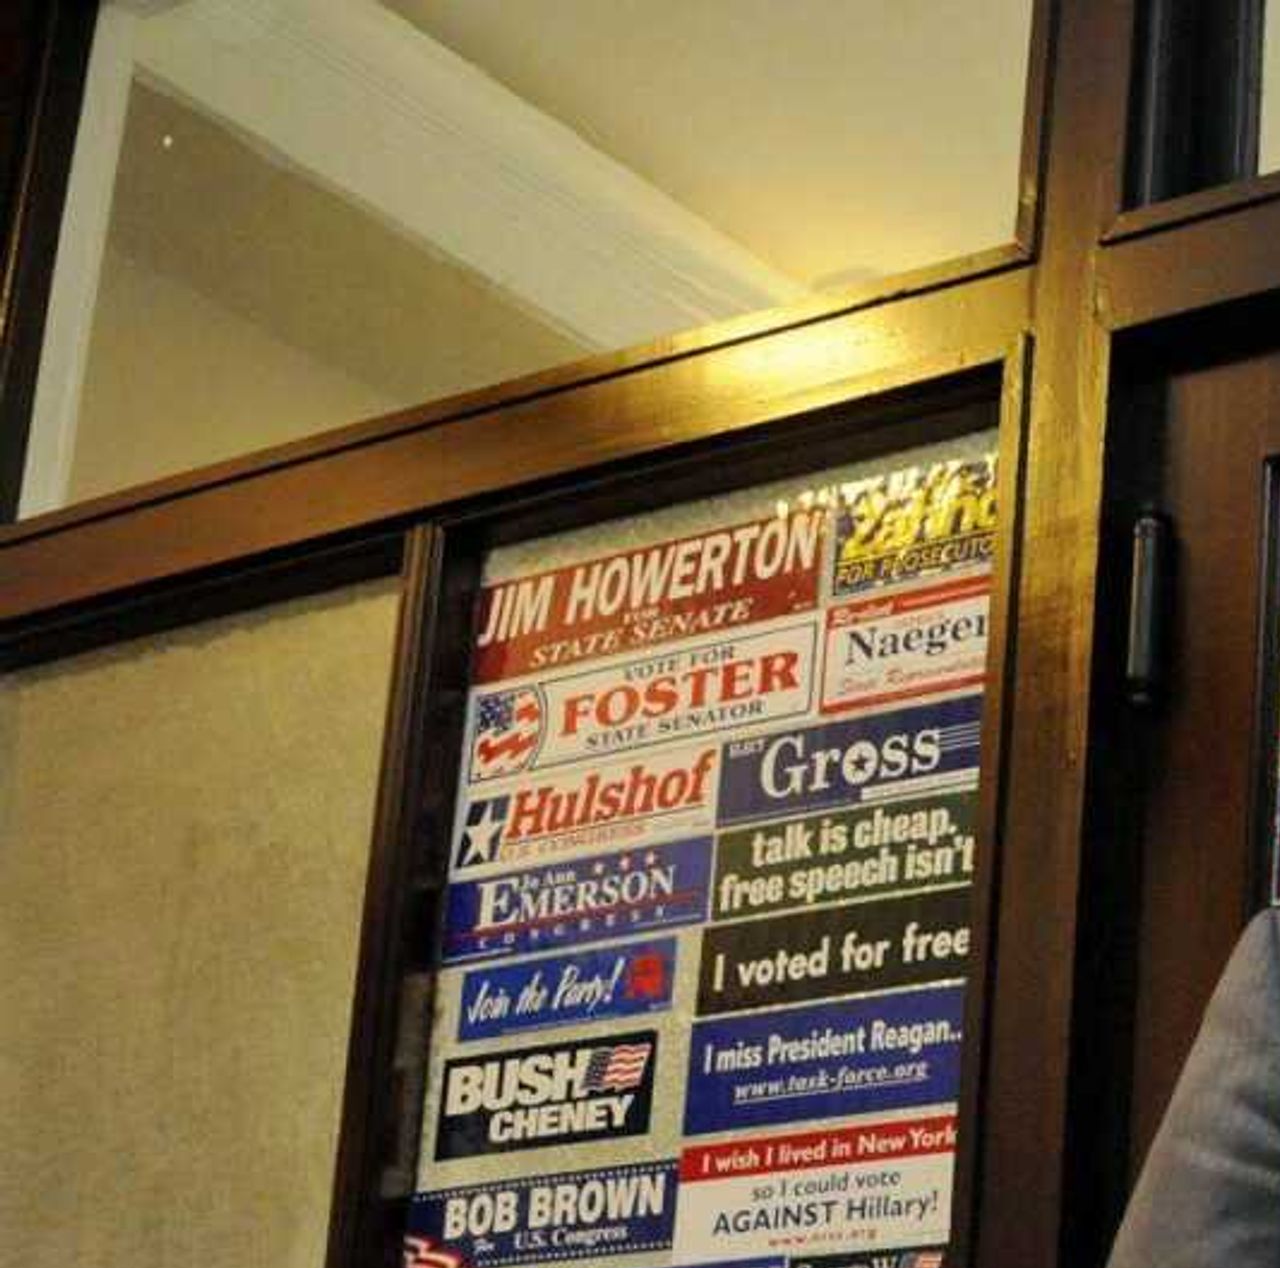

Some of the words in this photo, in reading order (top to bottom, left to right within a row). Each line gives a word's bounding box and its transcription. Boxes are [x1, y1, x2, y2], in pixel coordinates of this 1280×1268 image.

[478, 579, 556, 647] JIM
[565, 511, 822, 624] HOWERTON
[530, 627, 626, 667] STATE
[633, 598, 753, 645] SENATE
[561, 650, 801, 736] FOSTER
[586, 725, 649, 751] STATE
[658, 700, 765, 738] SENATOR
[507, 748, 716, 839] Hulshof
[761, 728, 941, 799] Gross
[752, 822, 812, 867] talk
[820, 819, 847, 855] is
[854, 807, 957, 848] cheap.
[474, 865, 676, 932] EMERSON
[720, 874, 783, 912] free
[790, 848, 897, 903] speech
[905, 836, 974, 880] isn't
[467, 979, 510, 1024] Join
[552, 956, 626, 1013] Party!
[713, 954, 725, 992] I
[738, 935, 830, 986] voted
[841, 931, 890, 972] for
[902, 922, 971, 962] free
[445, 1049, 594, 1116] BUSH
[715, 1042, 763, 1072] miss
[767, 1028, 866, 1064] President
[489, 1094, 634, 1143] CHENEY
[715, 1148, 759, 1173] wish
[777, 1141, 826, 1165] lived
[832, 1140, 850, 1158] in
[857, 1134, 905, 1156] New
[794, 1172, 849, 1197] could
[855, 1170, 901, 1190] vote
[444, 1191, 519, 1240] BOB
[528, 1173, 665, 1228] BROWN
[551, 1225, 630, 1248] Congress
[713, 1201, 839, 1237] AGAINST
[847, 1190, 938, 1223] Hillary!
